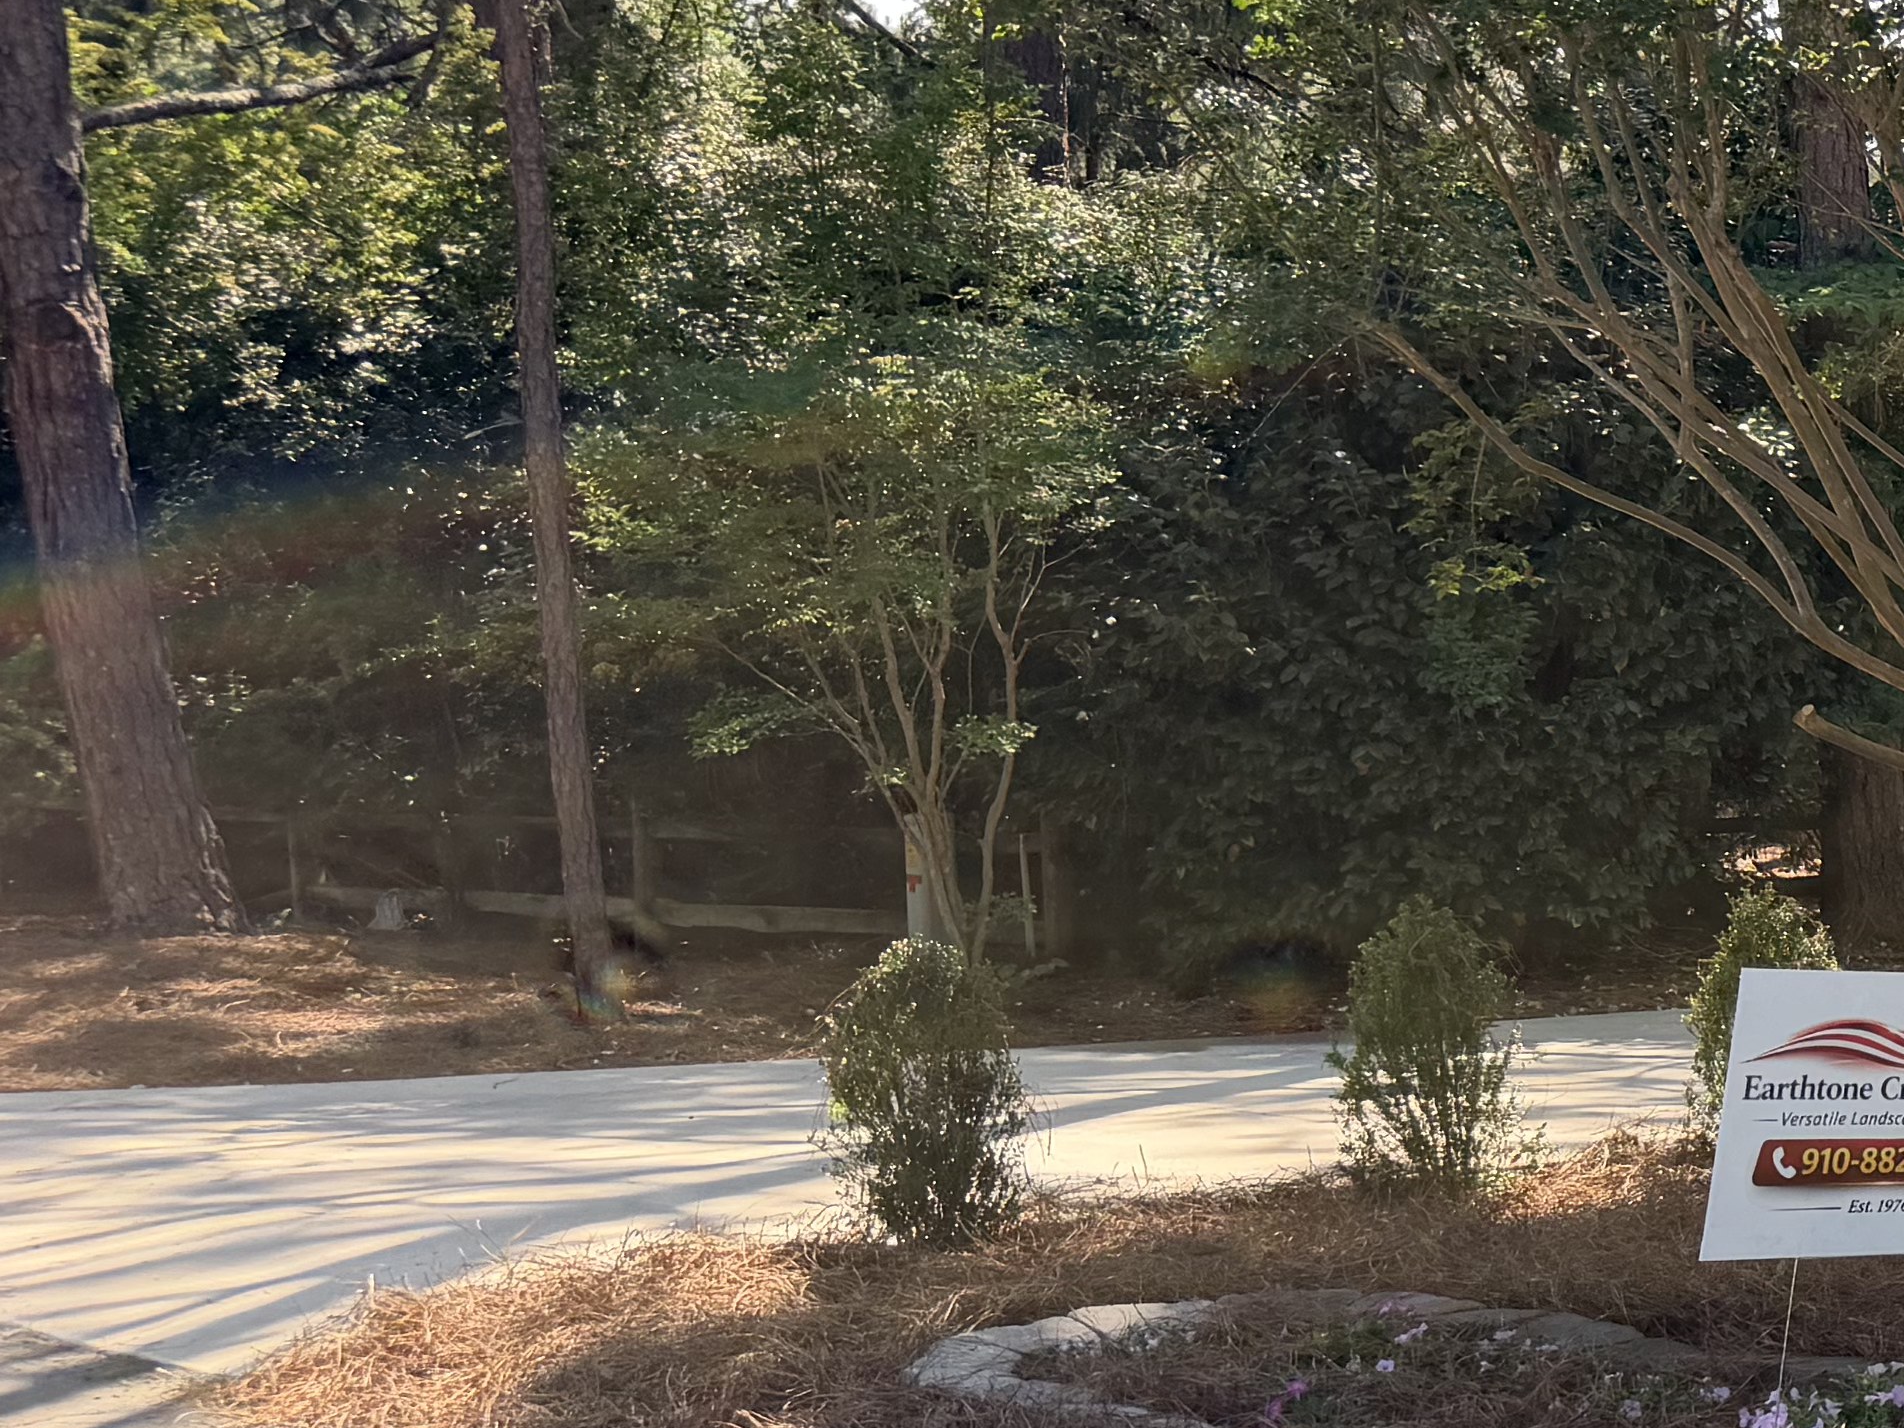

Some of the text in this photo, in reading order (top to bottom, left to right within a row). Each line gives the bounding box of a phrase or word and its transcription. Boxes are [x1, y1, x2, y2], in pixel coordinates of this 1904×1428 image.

[1742, 1075, 1873, 1100] Earthtone
[1782, 1111, 1846, 1126] Versatile
[1848, 1200, 1873, 1213] Est.
